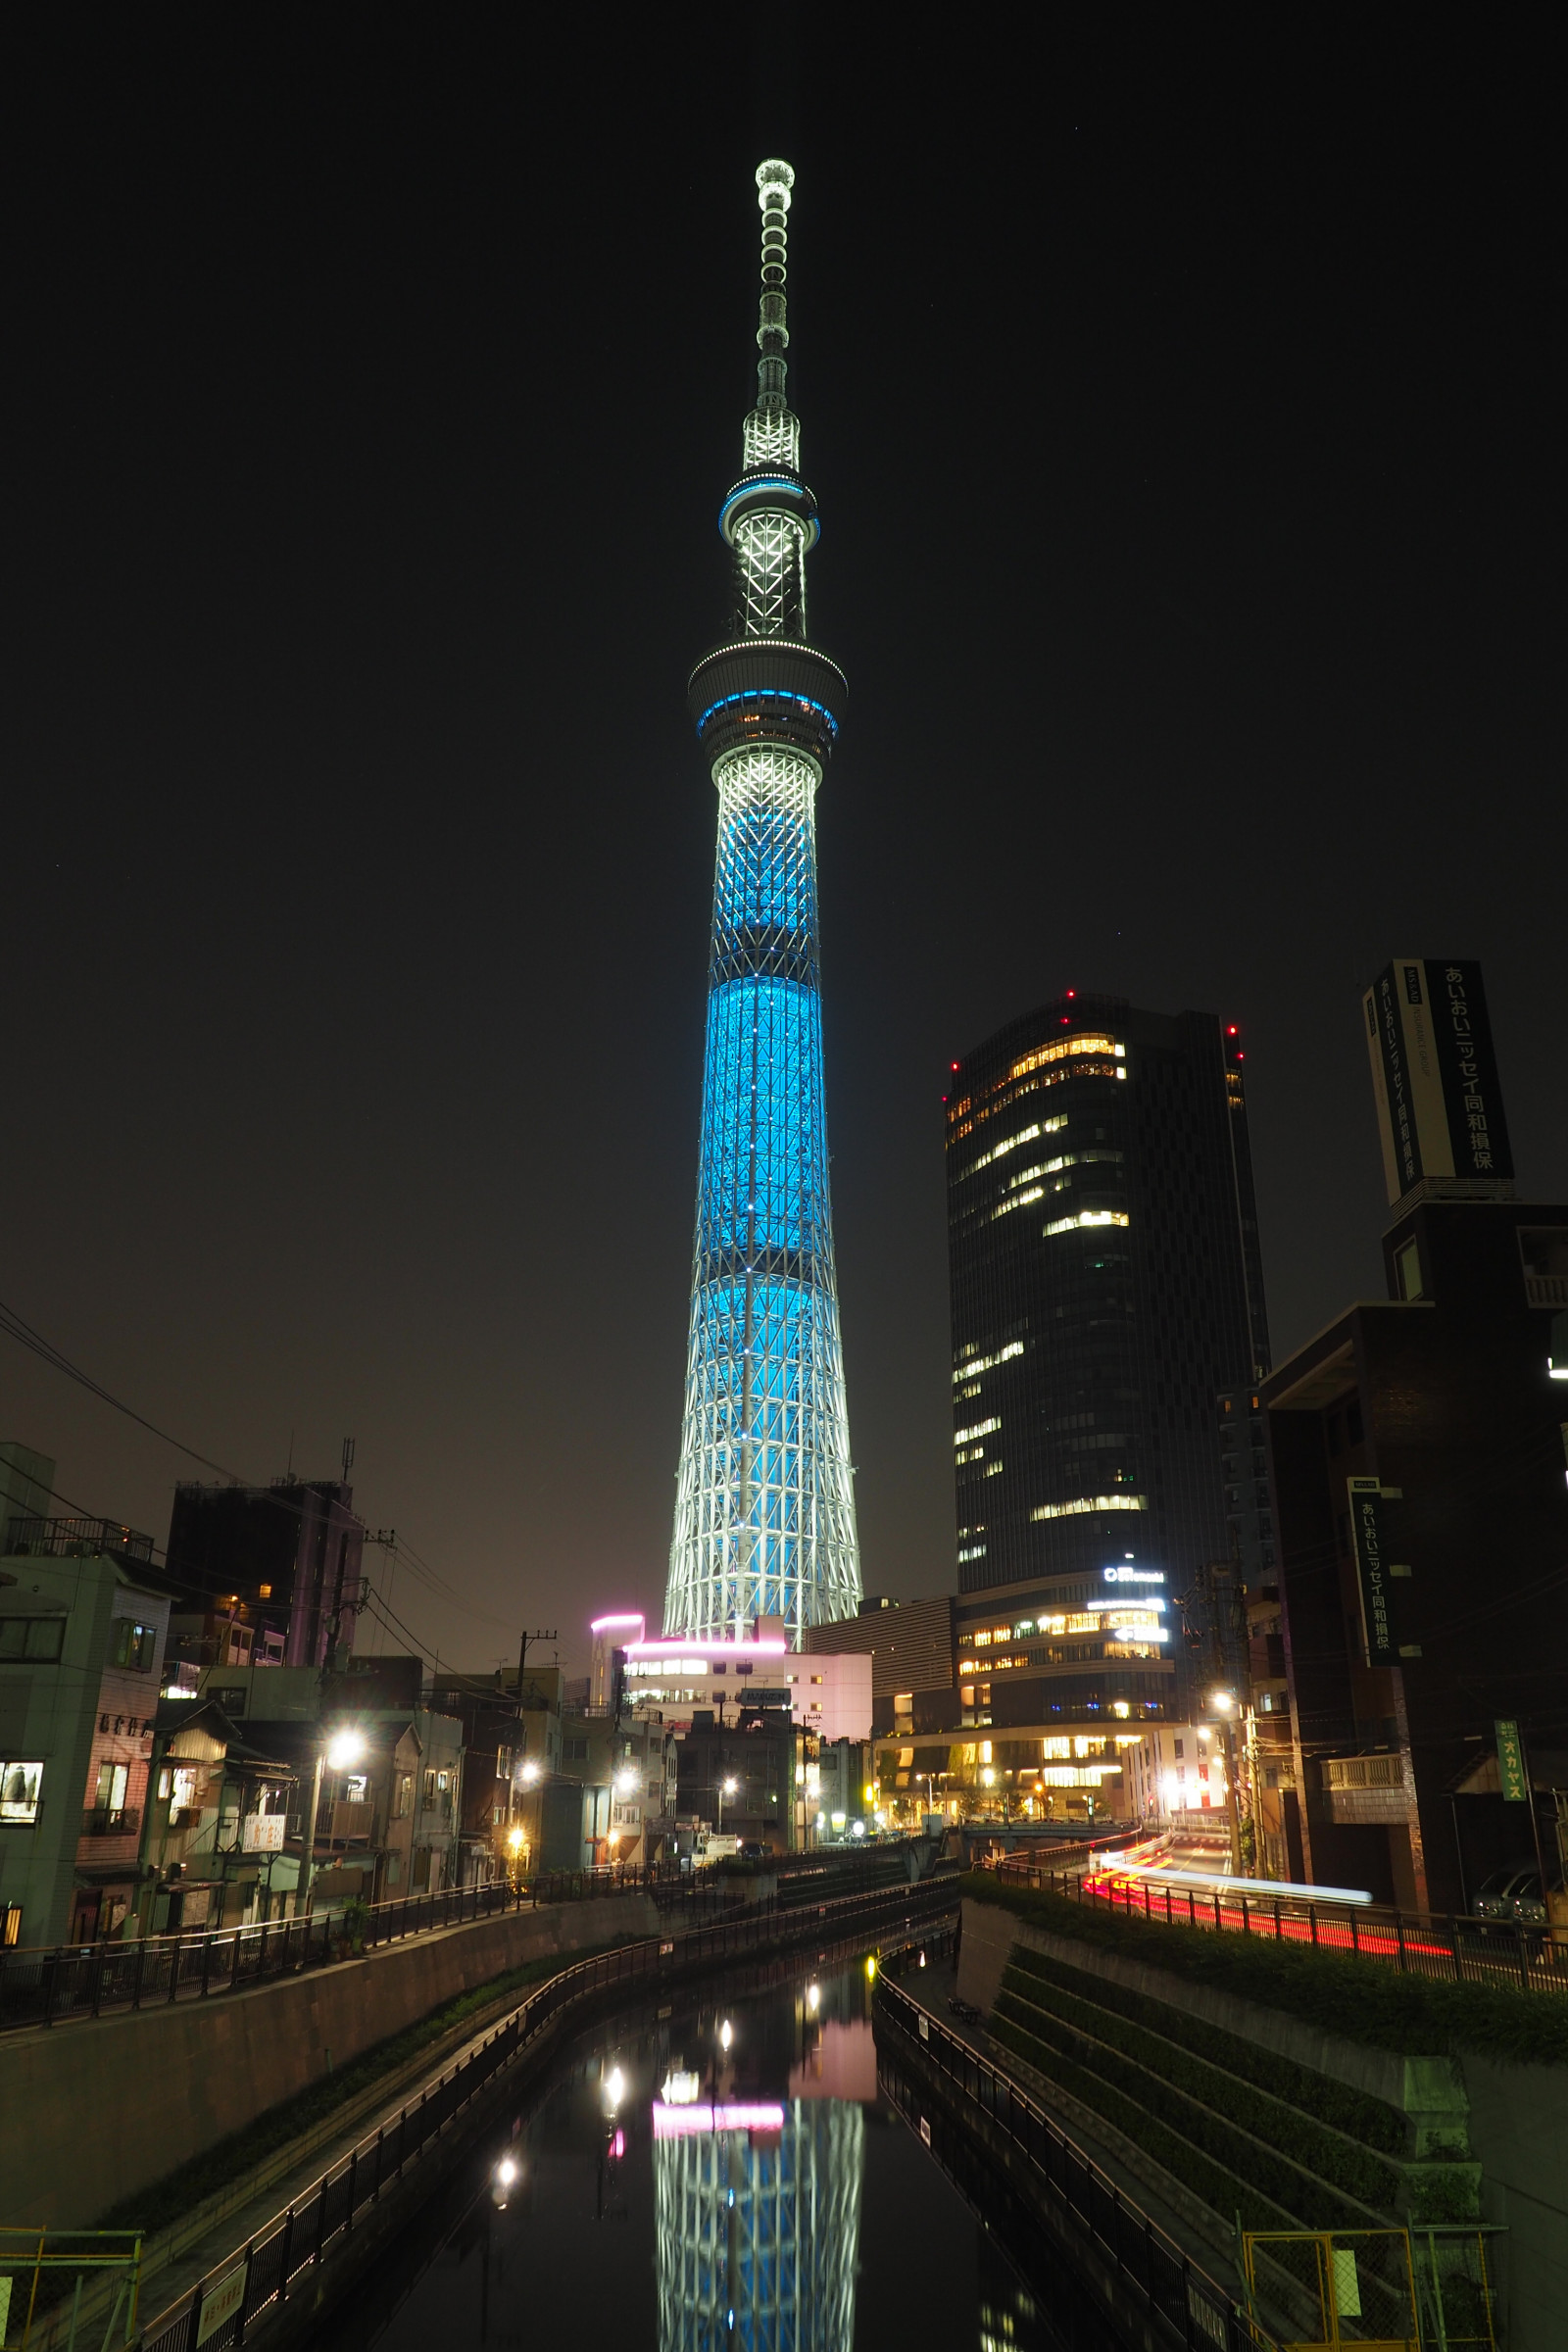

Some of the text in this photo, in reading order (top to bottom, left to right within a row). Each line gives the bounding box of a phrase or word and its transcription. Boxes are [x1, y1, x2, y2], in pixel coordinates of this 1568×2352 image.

[1406, 968, 1420, 1004] MS&AD
[1419, 1050, 1431, 1077] GROUP
[1445, 966, 1494, 1170] あいおいニッセイ同和損保
[1361, 1502, 1390, 1649] あいおいニッセイ同和損保
[1503, 1740, 1522, 1798] オカヤス
